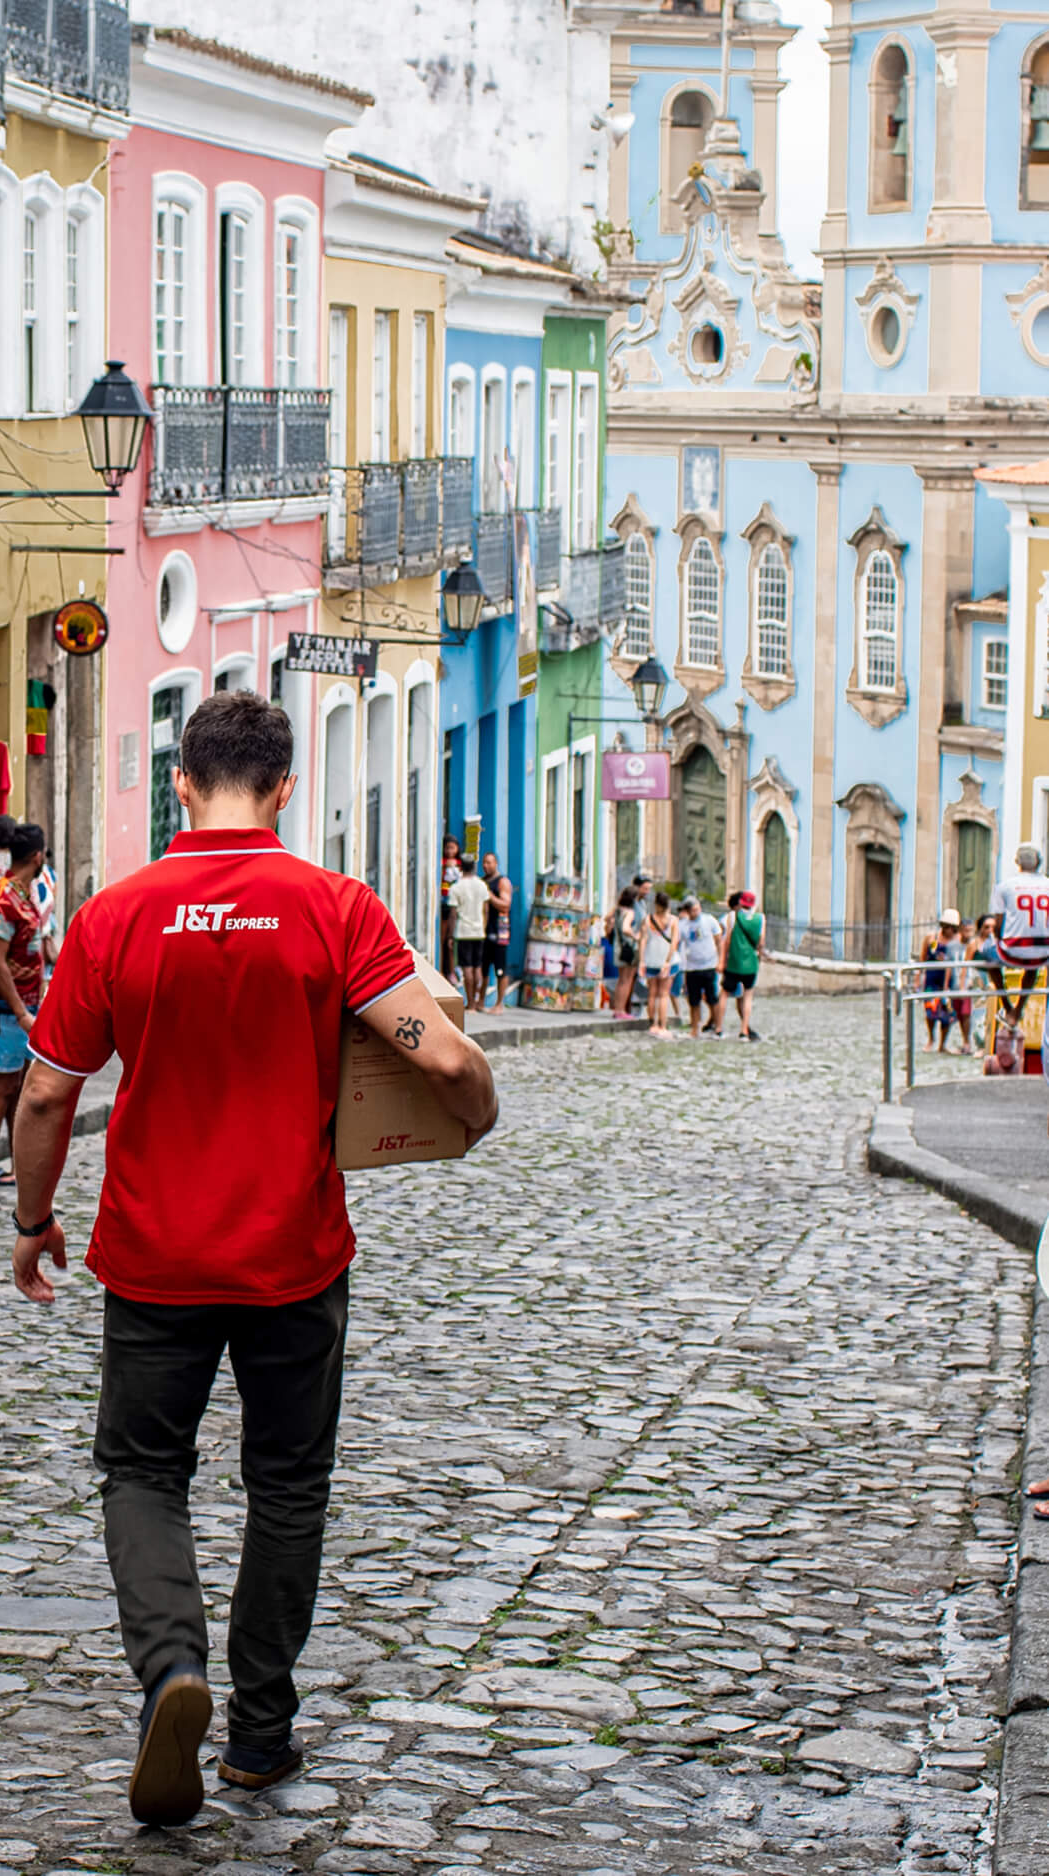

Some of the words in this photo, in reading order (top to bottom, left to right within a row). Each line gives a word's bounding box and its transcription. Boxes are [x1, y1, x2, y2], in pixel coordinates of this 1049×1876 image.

[162, 903, 237, 934] J&T
[225, 917, 280, 930] EXPRESS
[371, 1133, 412, 1152] J&T
